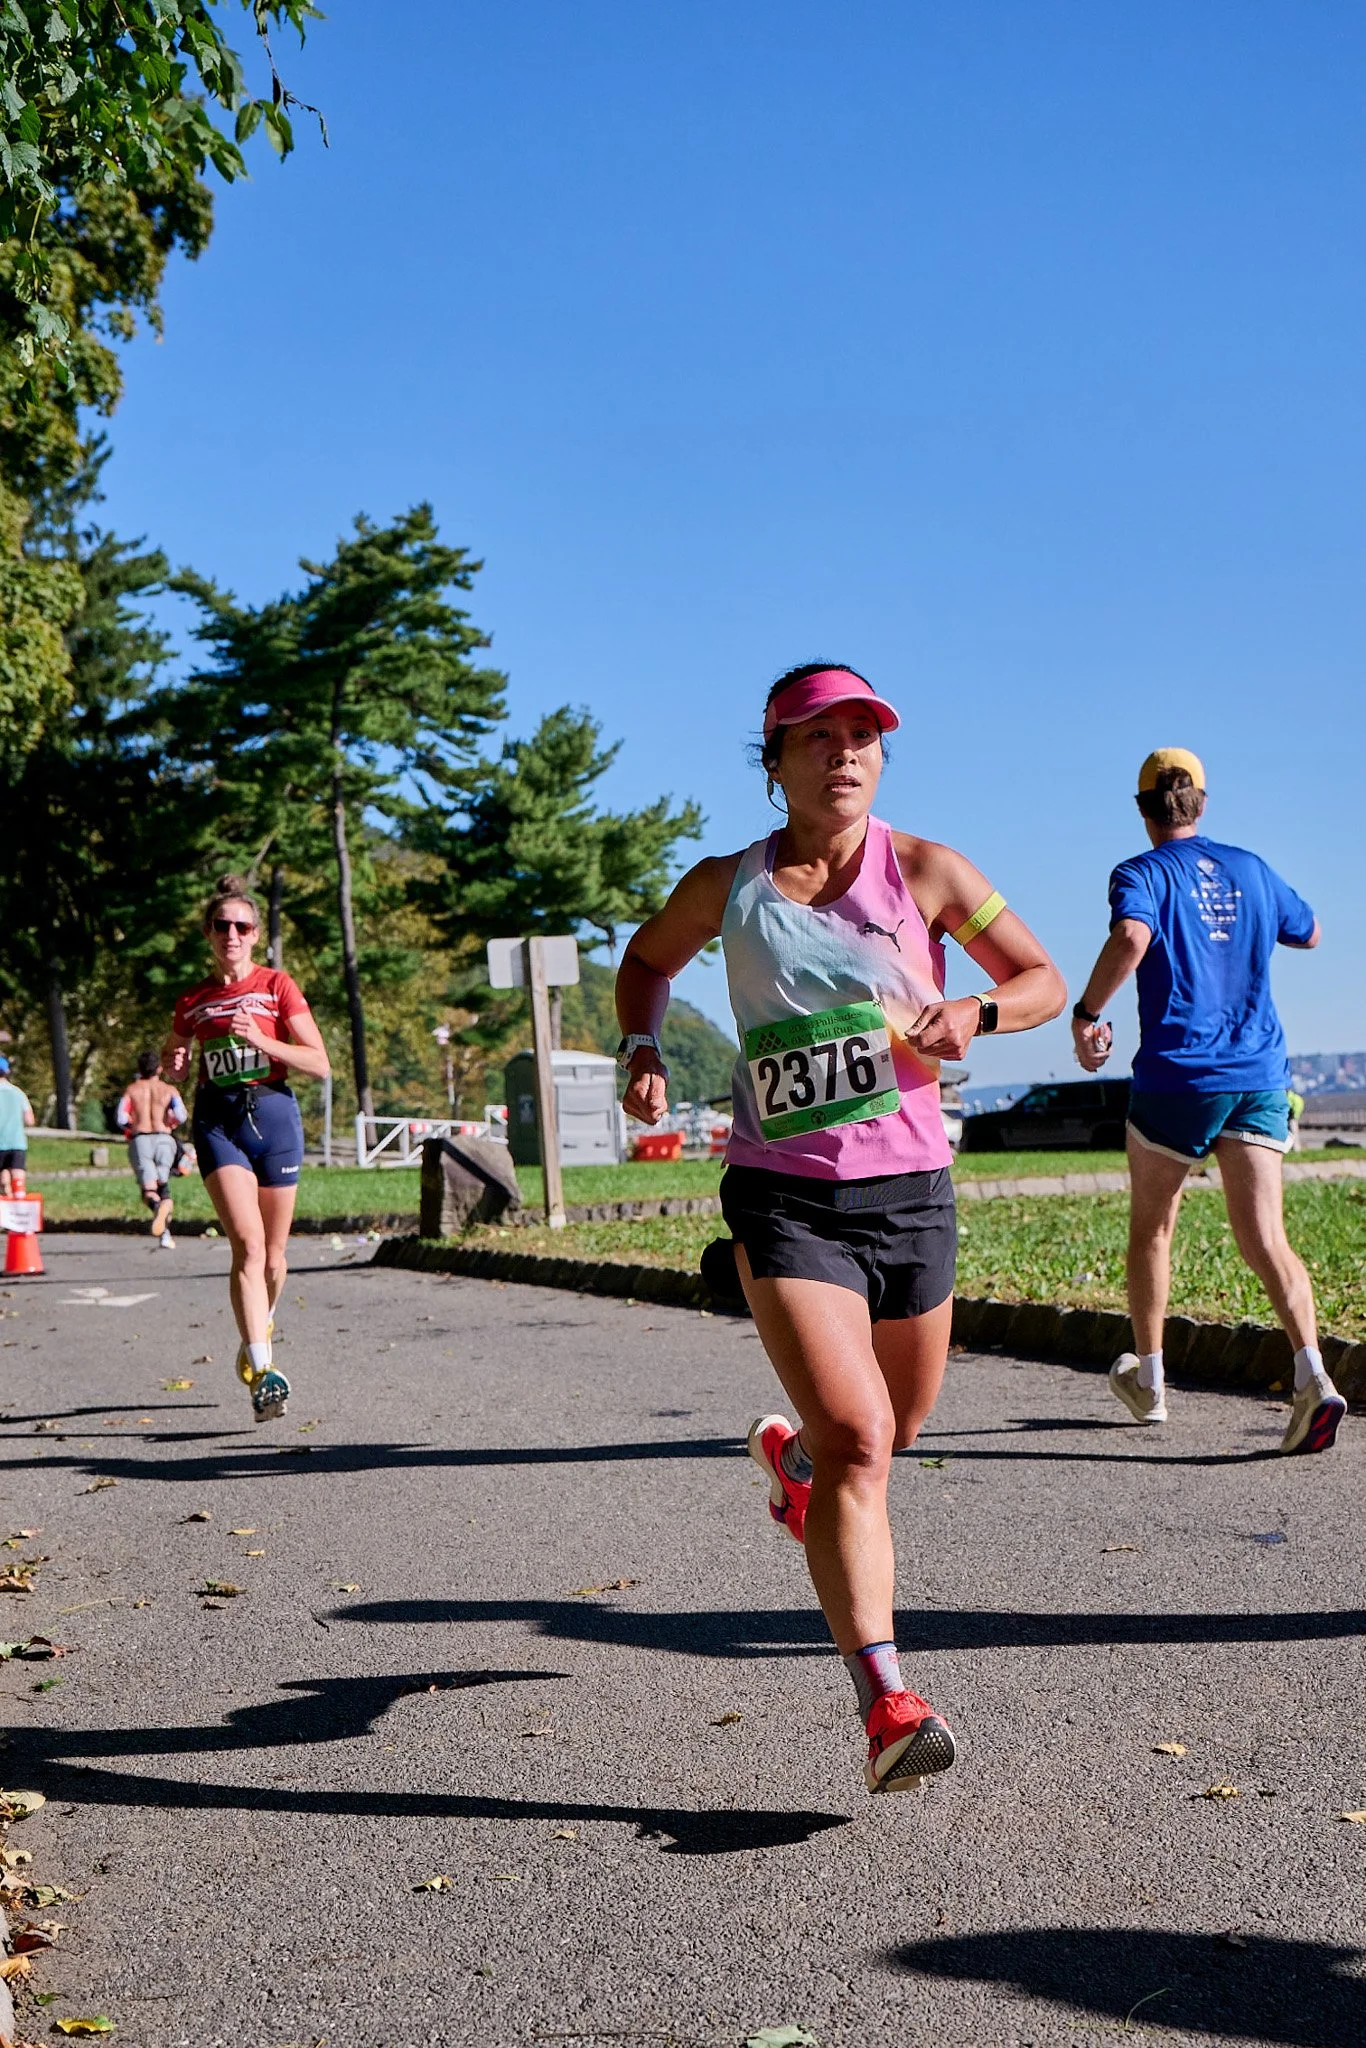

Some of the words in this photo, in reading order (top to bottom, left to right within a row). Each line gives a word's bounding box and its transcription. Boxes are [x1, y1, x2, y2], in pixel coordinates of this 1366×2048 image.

[815, 1012, 863, 1027] Palisades
[833, 1024, 854, 1037] Run
[757, 1036, 877, 1116] 2376
